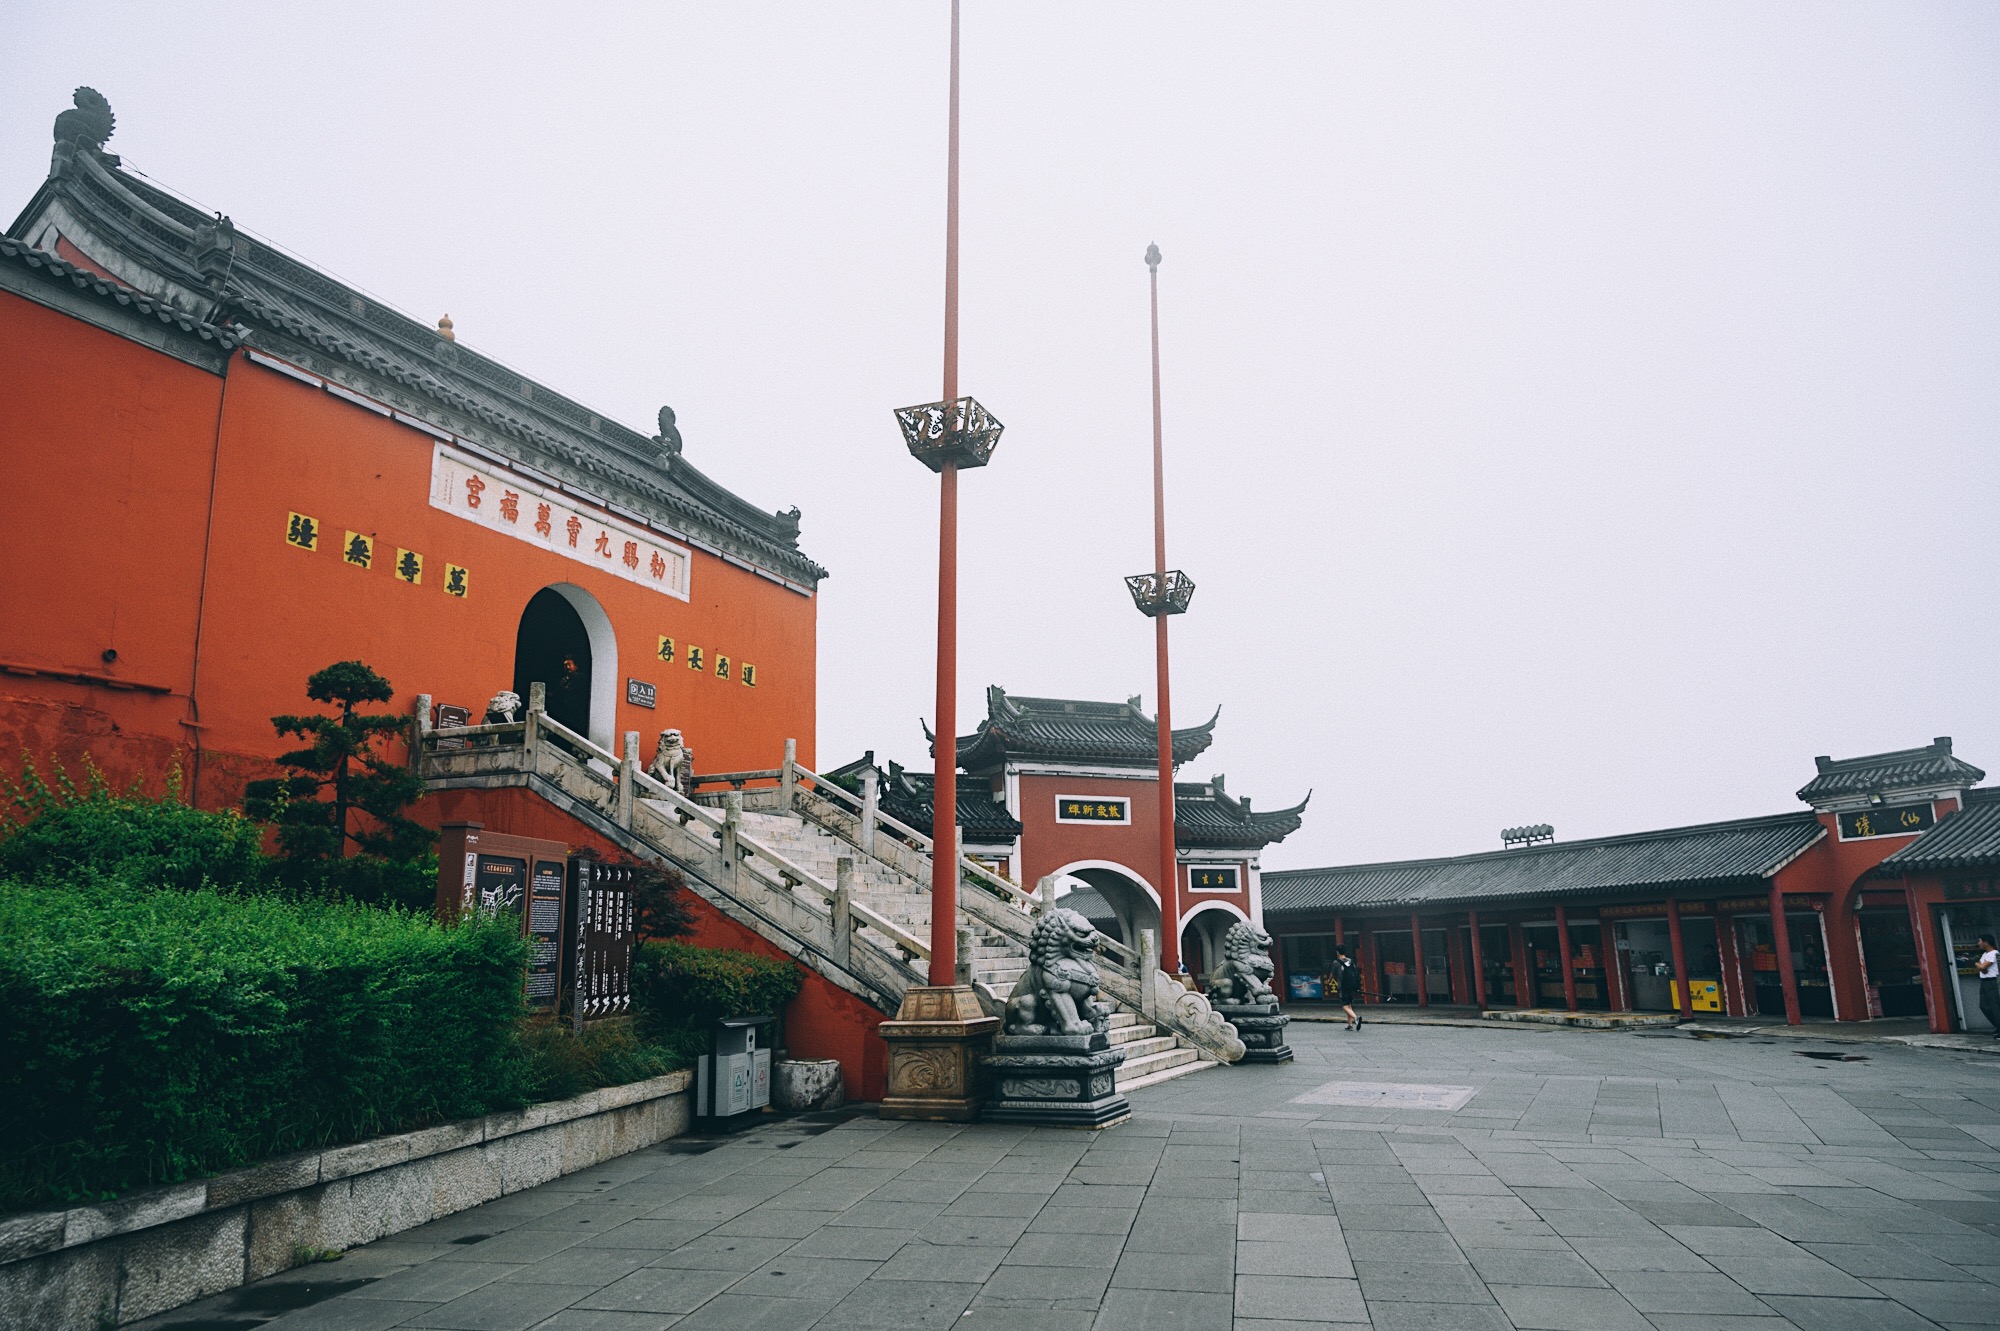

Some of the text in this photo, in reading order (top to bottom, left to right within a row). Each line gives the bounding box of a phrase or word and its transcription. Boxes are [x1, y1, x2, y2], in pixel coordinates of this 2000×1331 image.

[288, 515, 466, 597] 萬壽無疆
[639, 685, 654, 697] 入口
[1855, 811, 1921, 837] 仙境
